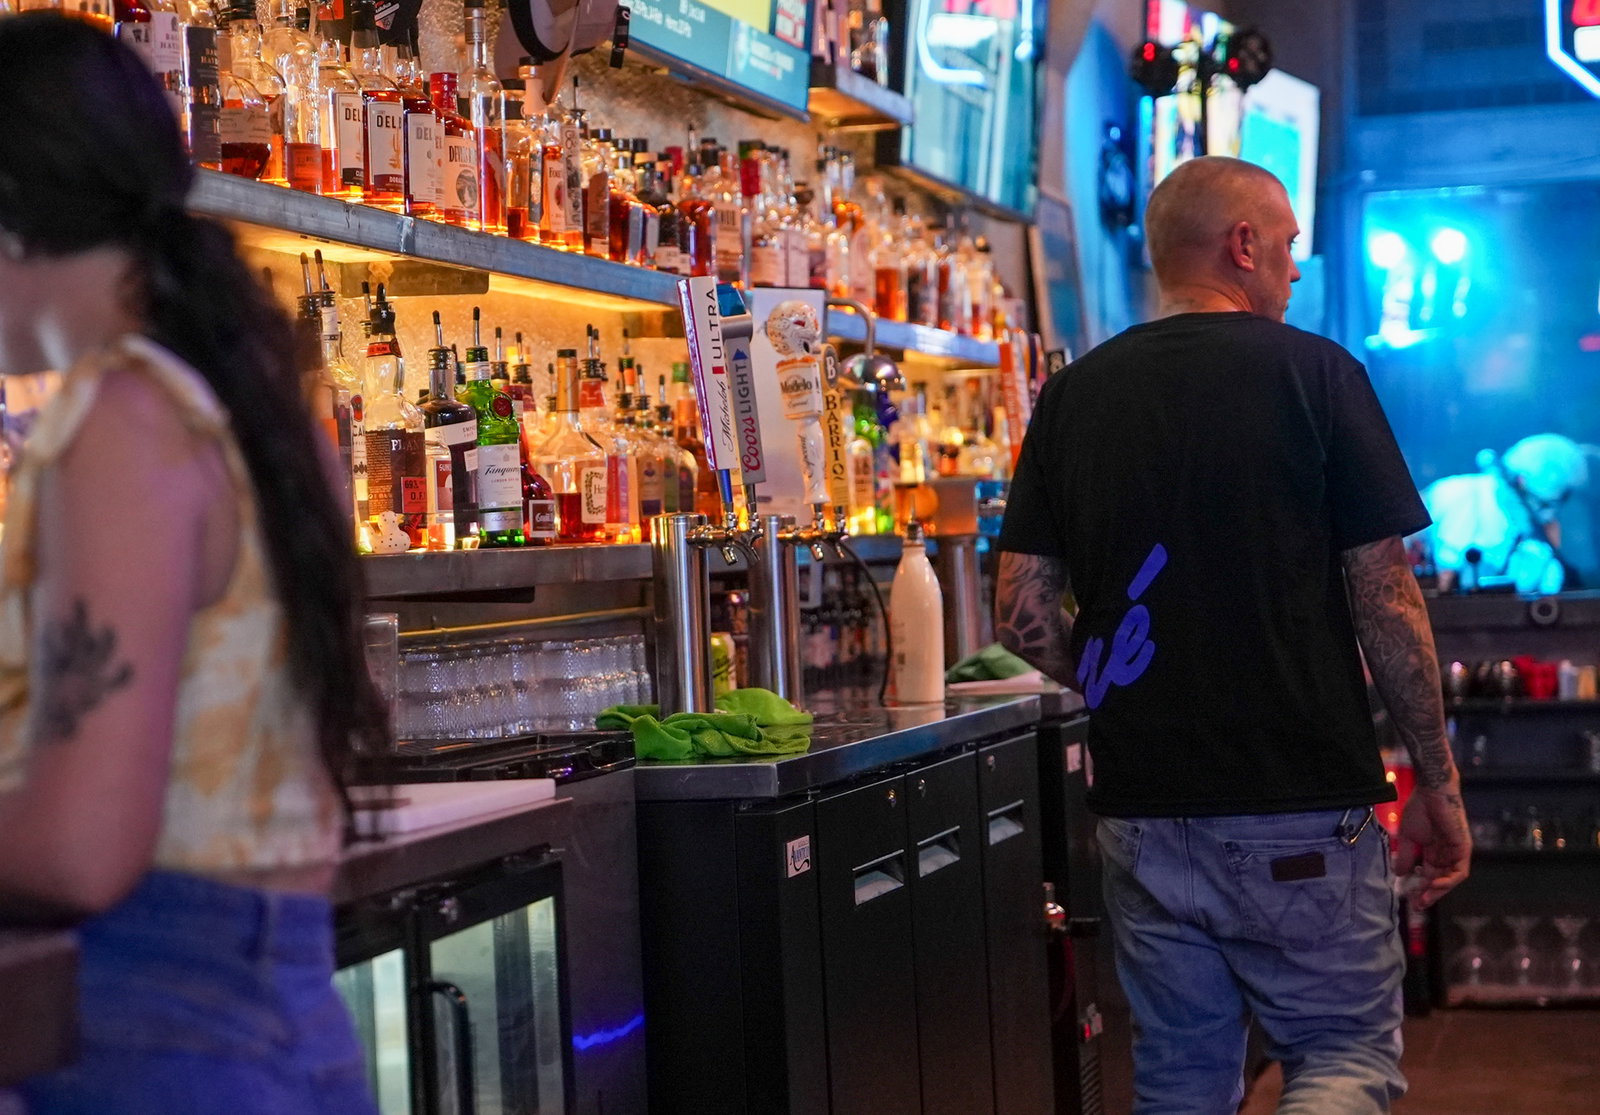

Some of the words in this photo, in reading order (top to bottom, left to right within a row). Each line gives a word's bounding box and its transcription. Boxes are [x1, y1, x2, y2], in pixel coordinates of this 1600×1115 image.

[376, 115, 397, 129] DEL
[706, 288, 723, 359] ULTRA
[736, 364, 751, 414] LIGHT
[780, 378, 813, 394] Modelo
[717, 379, 734, 453] Michelob
[825, 395, 845, 476] BARRIO
[741, 417, 762, 473] Coors
